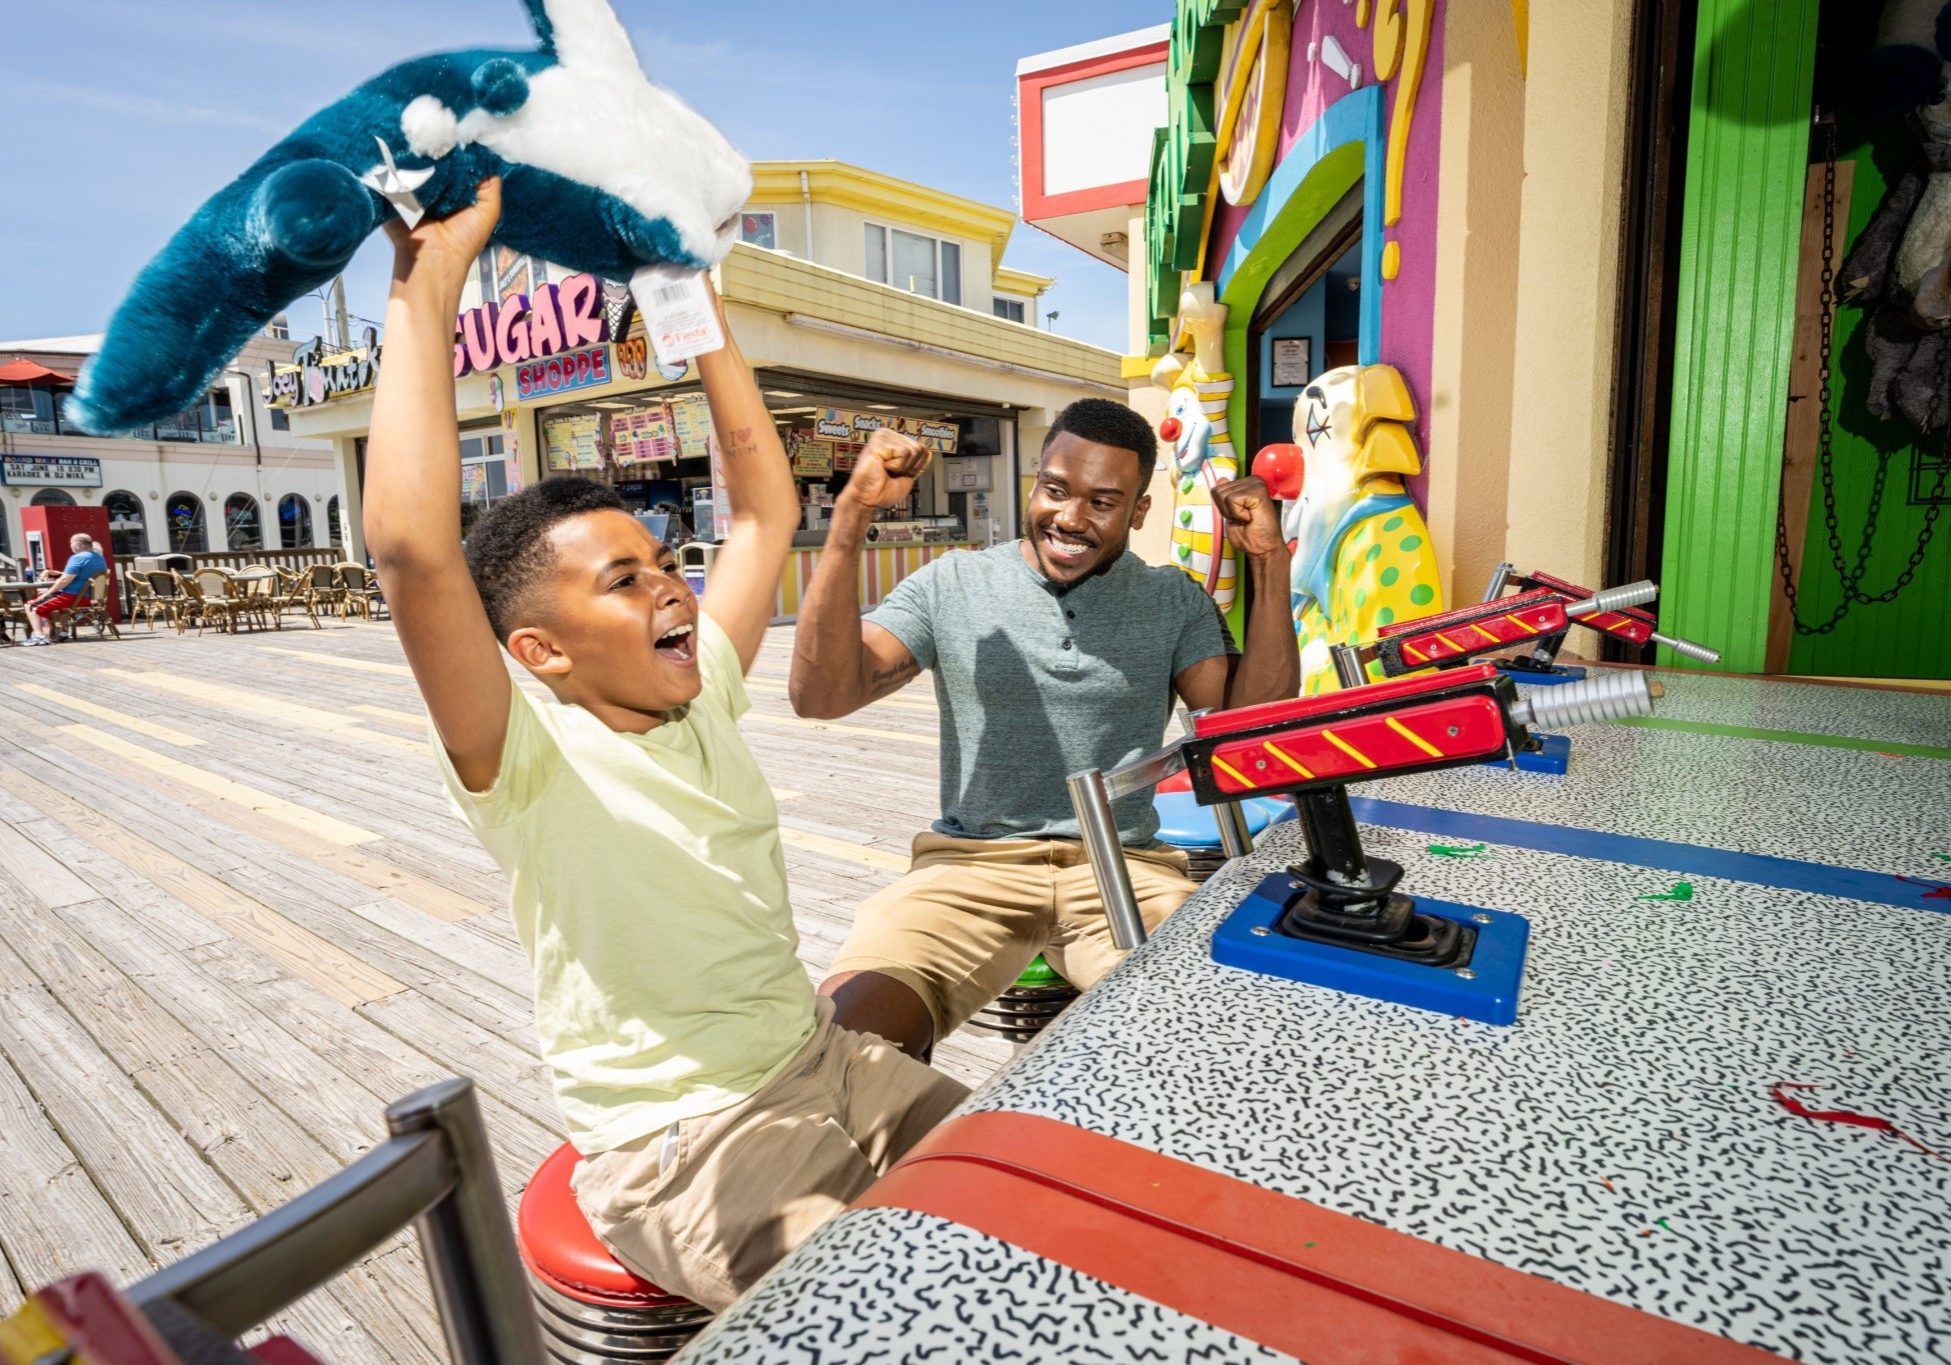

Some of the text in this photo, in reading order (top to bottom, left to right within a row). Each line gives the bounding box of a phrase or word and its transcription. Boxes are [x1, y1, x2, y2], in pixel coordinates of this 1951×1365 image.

[518, 348, 606, 396] SHOPPE
[262, 360, 300, 406] Joey
[818, 419, 851, 438] Sweets
[853, 415, 883, 432] Snacks
[921, 424, 956, 440] Smoothies
[729, 431, 738, 447] I
[7, 471, 41, 479] KARAOKE
[10, 463, 25, 471] SAT
[31, 464, 49, 472] JUNE
